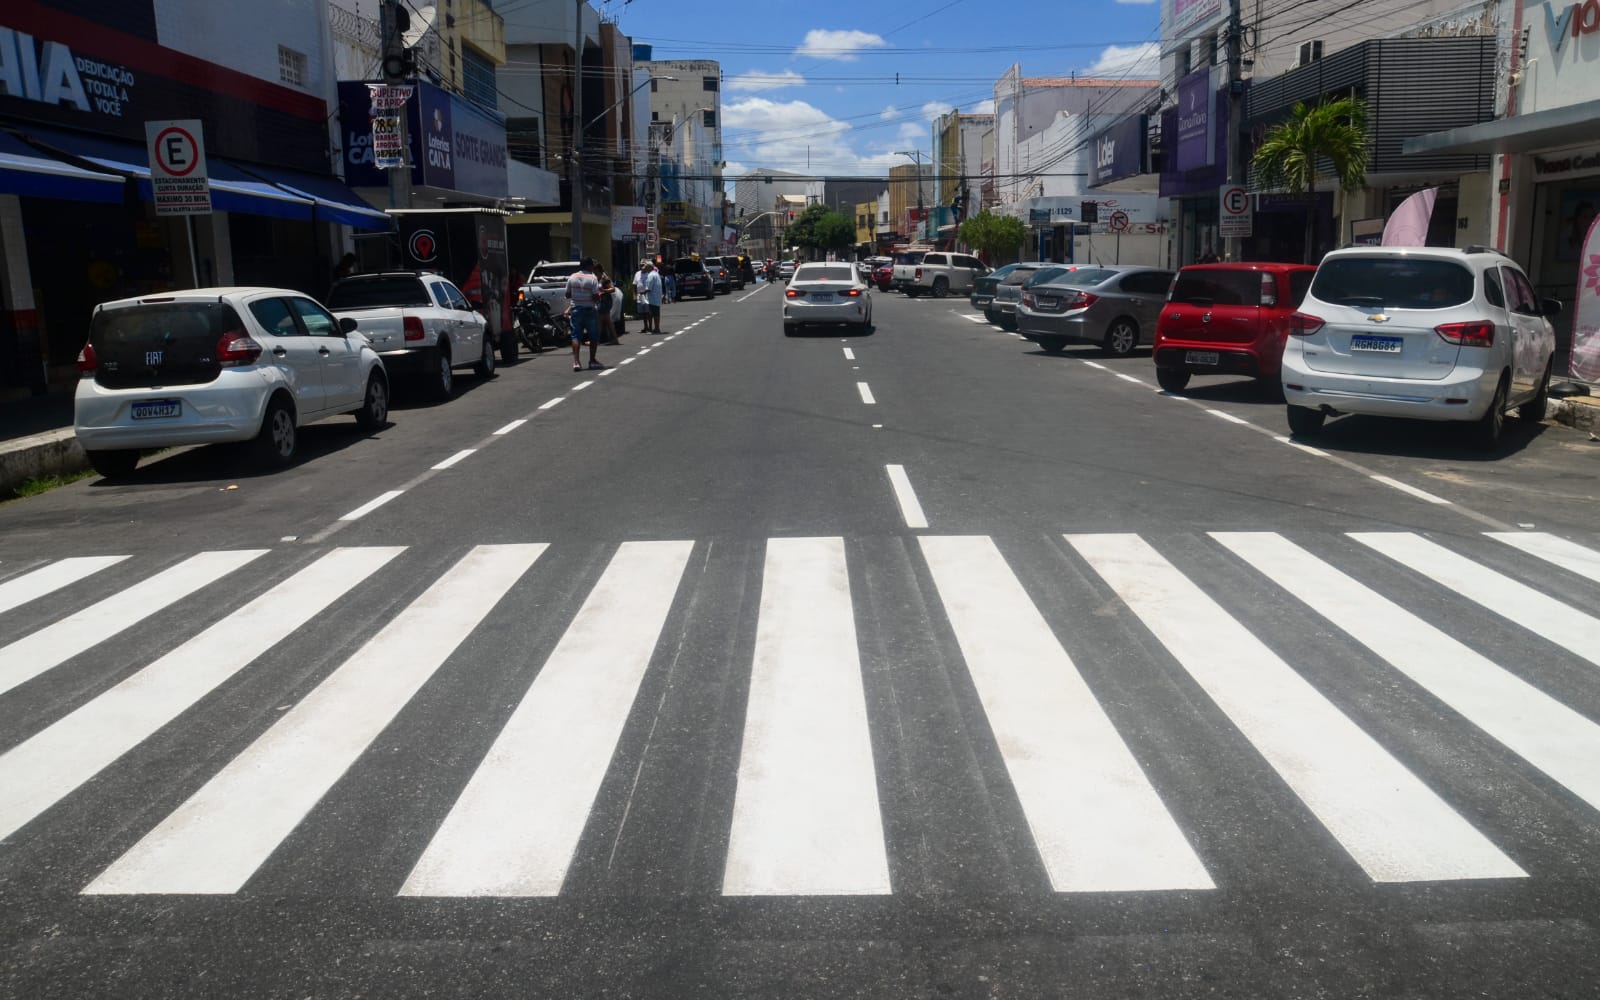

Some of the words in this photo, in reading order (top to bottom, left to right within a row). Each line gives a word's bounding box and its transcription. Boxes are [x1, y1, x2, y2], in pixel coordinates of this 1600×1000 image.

[76, 57, 134, 87] DEDICAÇÃO
[84, 79, 119, 100] TOTAL
[120, 88, 129, 103] A
[372, 88, 411, 98] SUPLETIVO
[96, 97, 122, 117] VOCÊ
[167, 138, 186, 165] E
[429, 133, 450, 153] Loterias
[456, 132, 479, 162] SORTE
[481, 140, 507, 169] GRANDE
[429, 148, 451, 170] CAIXA
[1231, 193, 1241, 209] E
[146, 352, 163, 365] FIAT
